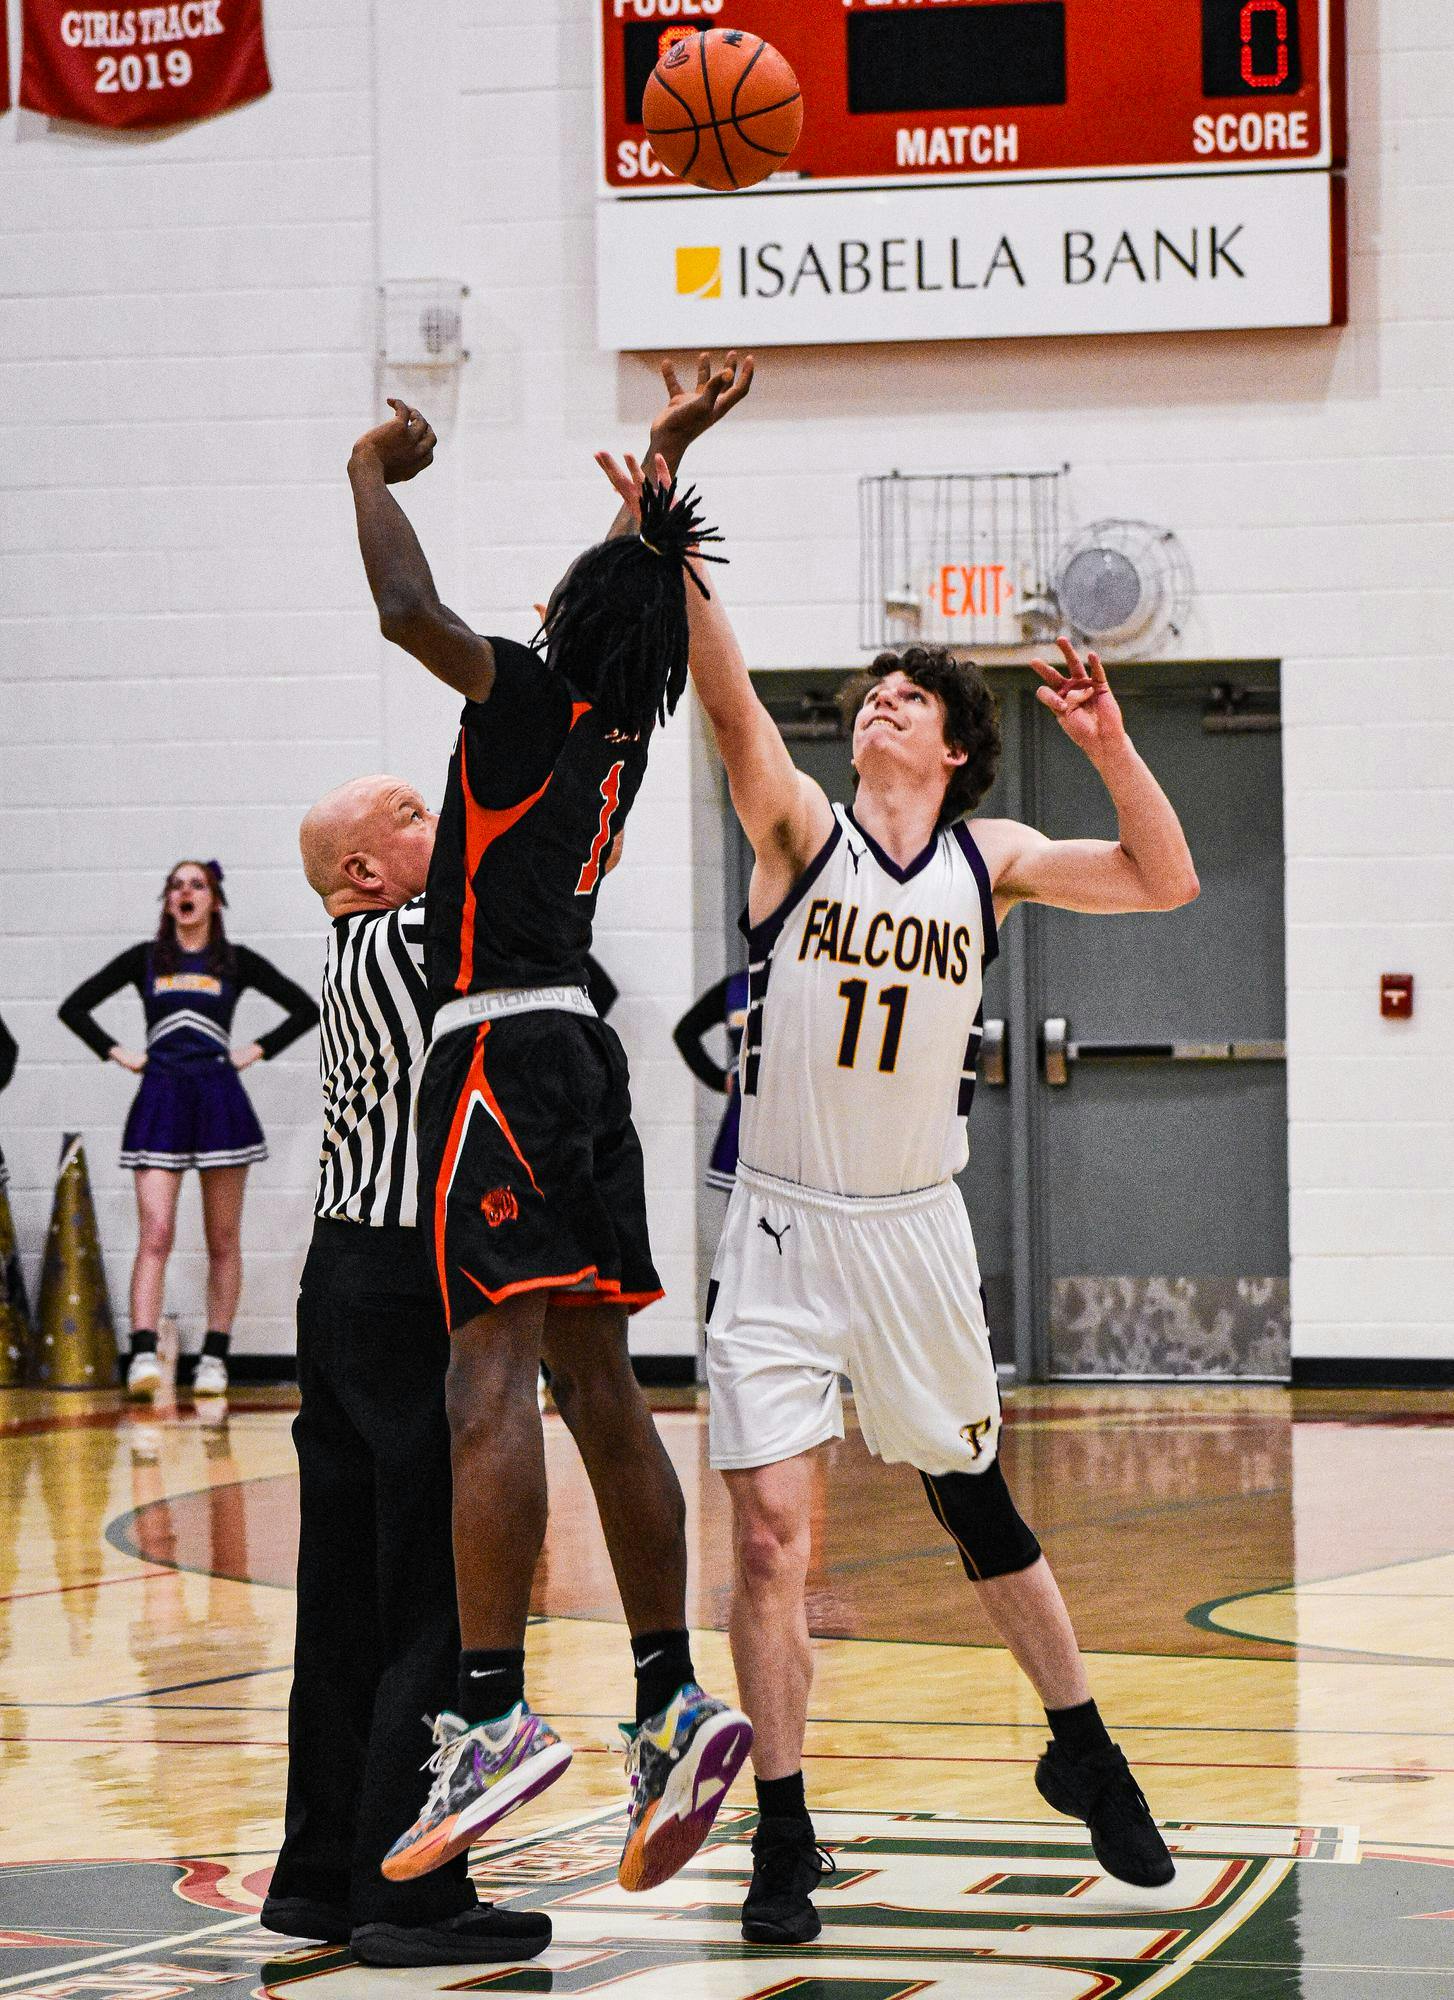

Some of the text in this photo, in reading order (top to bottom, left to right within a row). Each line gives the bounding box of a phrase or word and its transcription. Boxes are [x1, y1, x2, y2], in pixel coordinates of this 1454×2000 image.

[60, 0, 225, 48] GIRLS TRACK
[94, 49, 193, 93] 2019
[895, 123, 1018, 167] MATCH
[1192, 110, 1309, 154] SCORE
[738, 223, 1246, 299] ISABELLA BANK
[939, 564, 1006, 618] EXIT
[574, 760, 625, 896] 1
[798, 898, 971, 985] FALCONS
[837, 977, 909, 1075] 11
